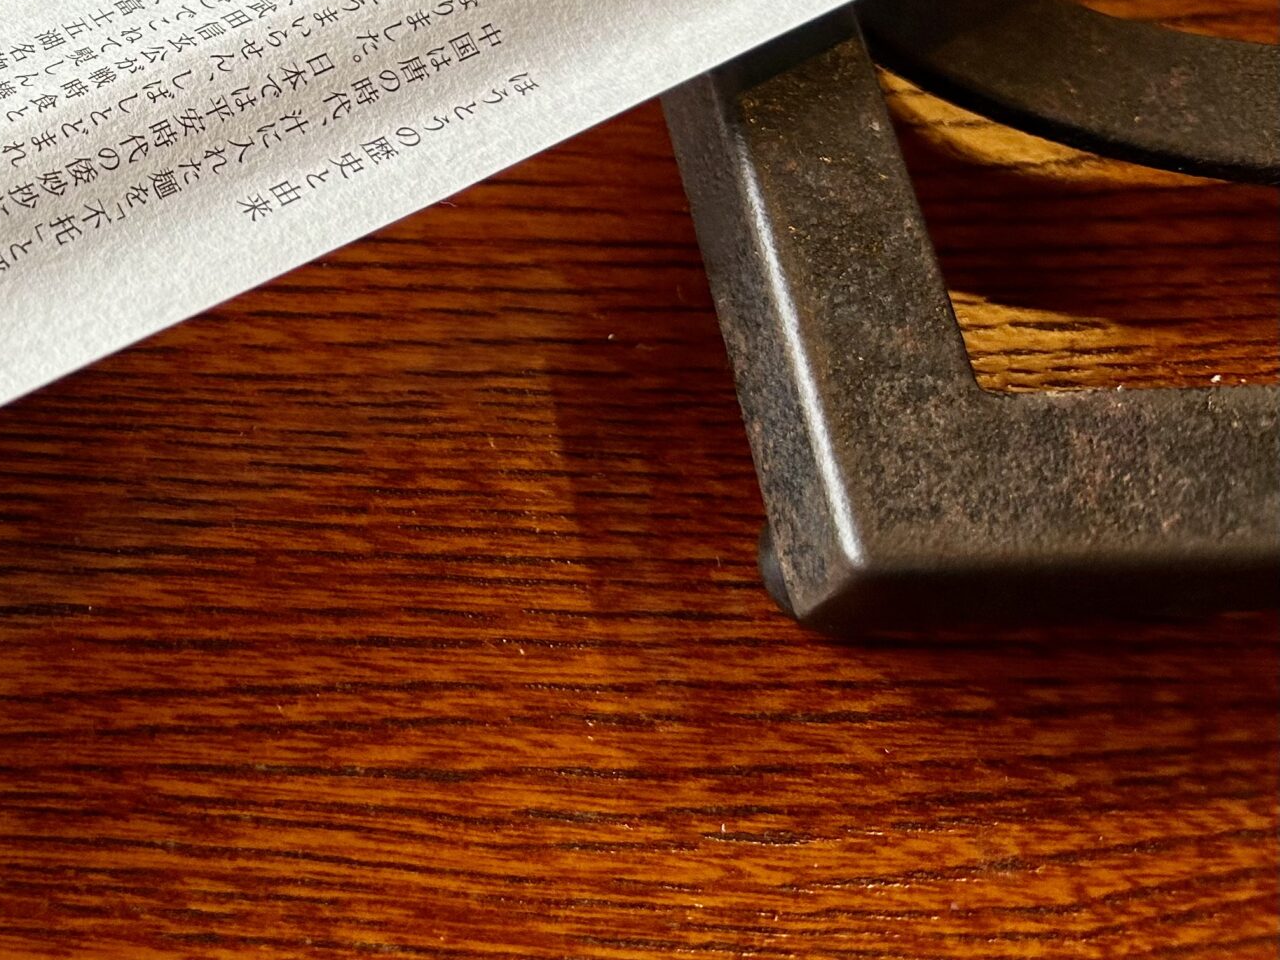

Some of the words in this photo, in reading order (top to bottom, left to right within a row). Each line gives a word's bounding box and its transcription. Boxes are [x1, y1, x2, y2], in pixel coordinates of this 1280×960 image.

[239, 72, 539, 221] ほうとうの歴史と由来
